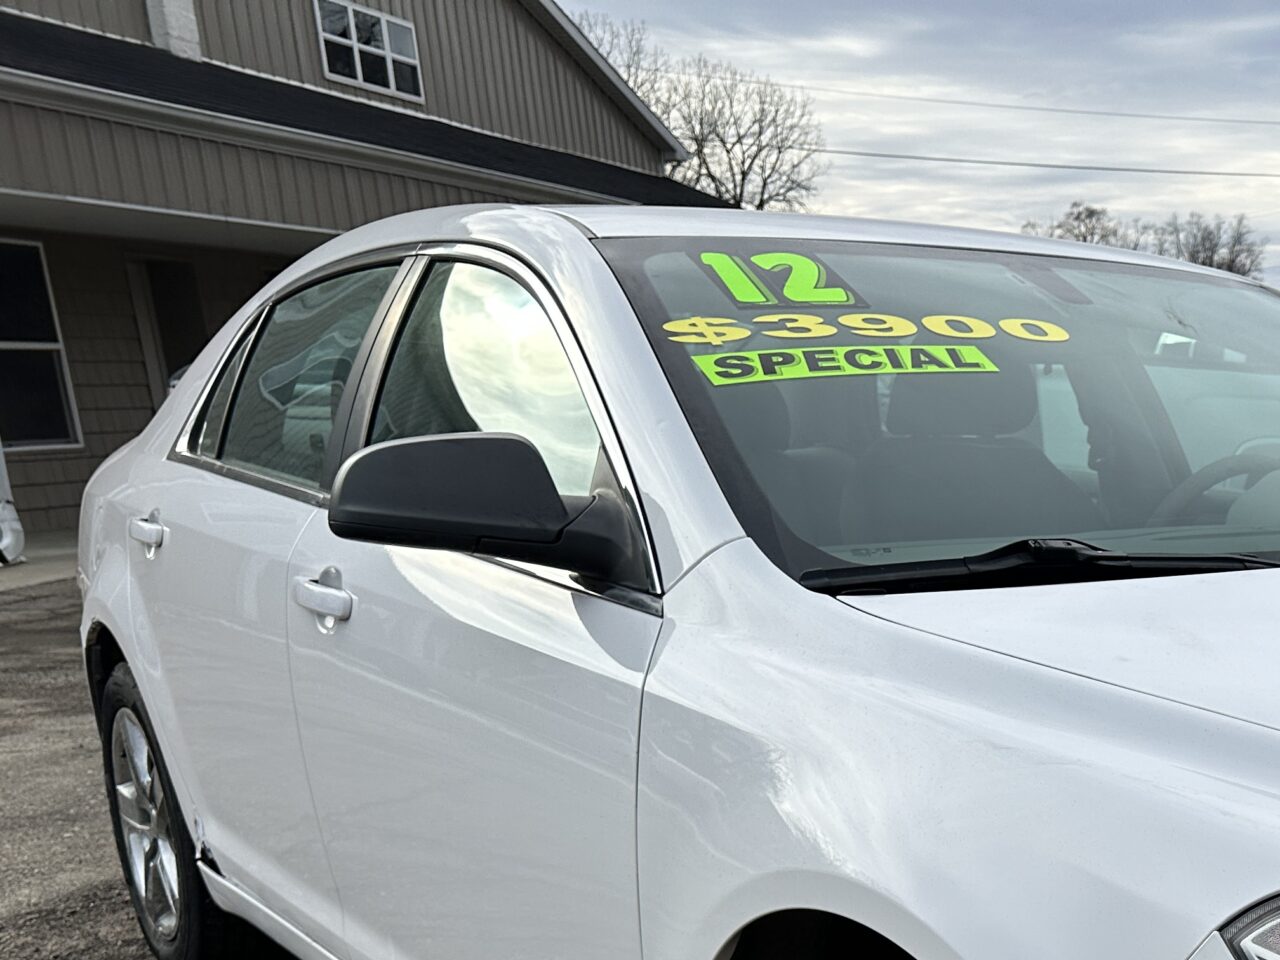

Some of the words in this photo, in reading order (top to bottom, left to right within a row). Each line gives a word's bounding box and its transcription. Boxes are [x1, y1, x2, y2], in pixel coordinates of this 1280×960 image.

[700, 252, 853, 304] 12
[662, 313, 1071, 346] $3900
[713, 347, 984, 380] SPECIAL
